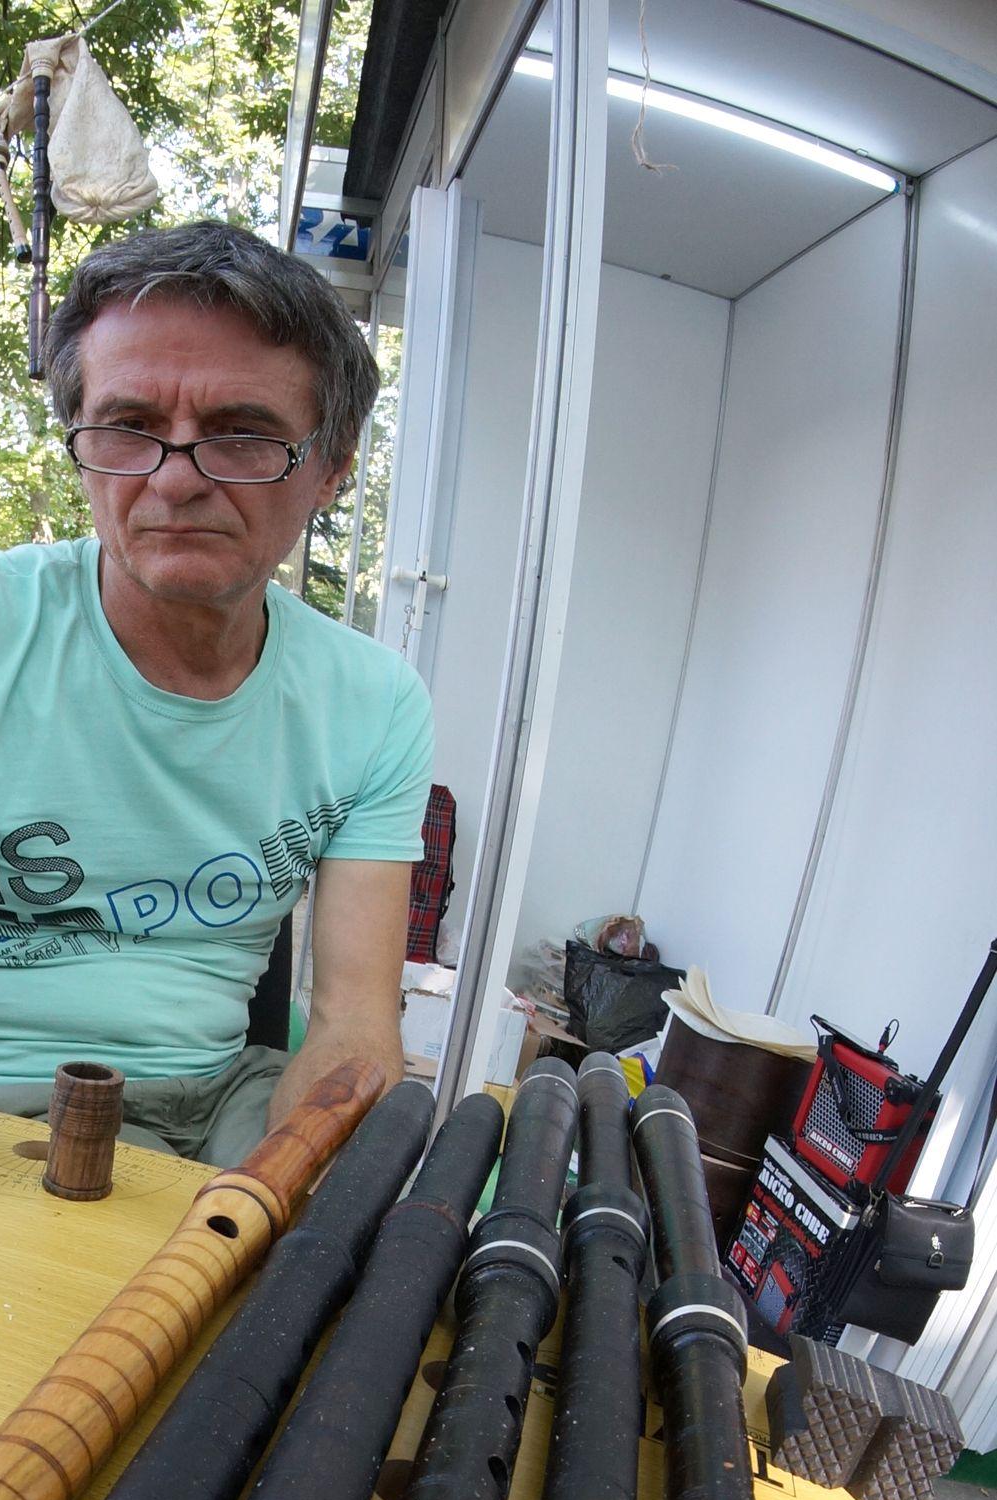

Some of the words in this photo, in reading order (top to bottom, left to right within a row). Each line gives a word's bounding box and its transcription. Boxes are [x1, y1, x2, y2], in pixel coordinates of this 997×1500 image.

[809, 1130, 833, 1152] MICRO
[832, 1146, 854, 1168] CUBE
[758, 1167, 795, 1209] MICRO
[794, 1202, 830, 1245] CUBE
